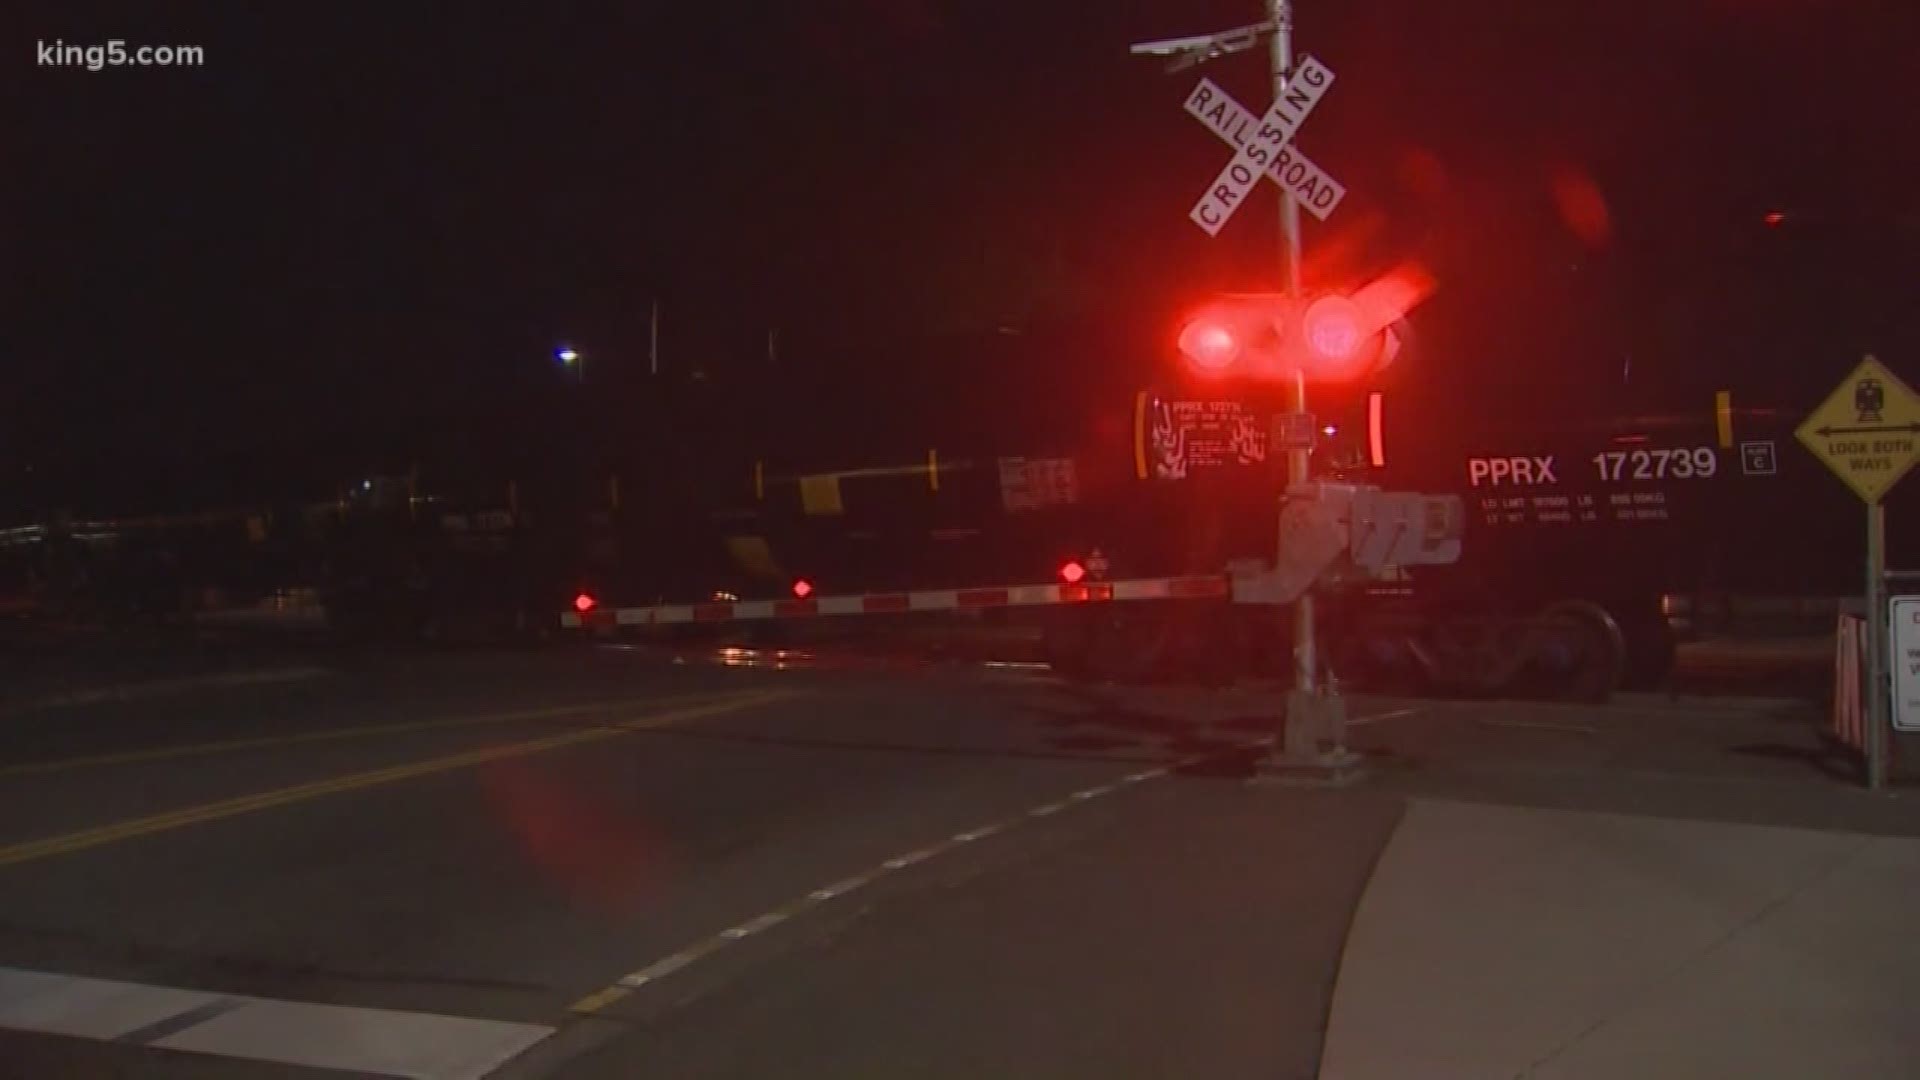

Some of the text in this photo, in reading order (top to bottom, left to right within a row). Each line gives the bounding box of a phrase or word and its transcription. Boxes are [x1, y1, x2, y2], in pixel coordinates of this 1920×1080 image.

[1191, 88, 1335, 209] RAIL ROAD
[1199, 66, 1325, 227] CROSSING
[1469, 447, 1716, 486] PPRX 172739
[1828, 439, 1913, 455] LOOK BOTH
[1850, 457, 1891, 471] WAYS
